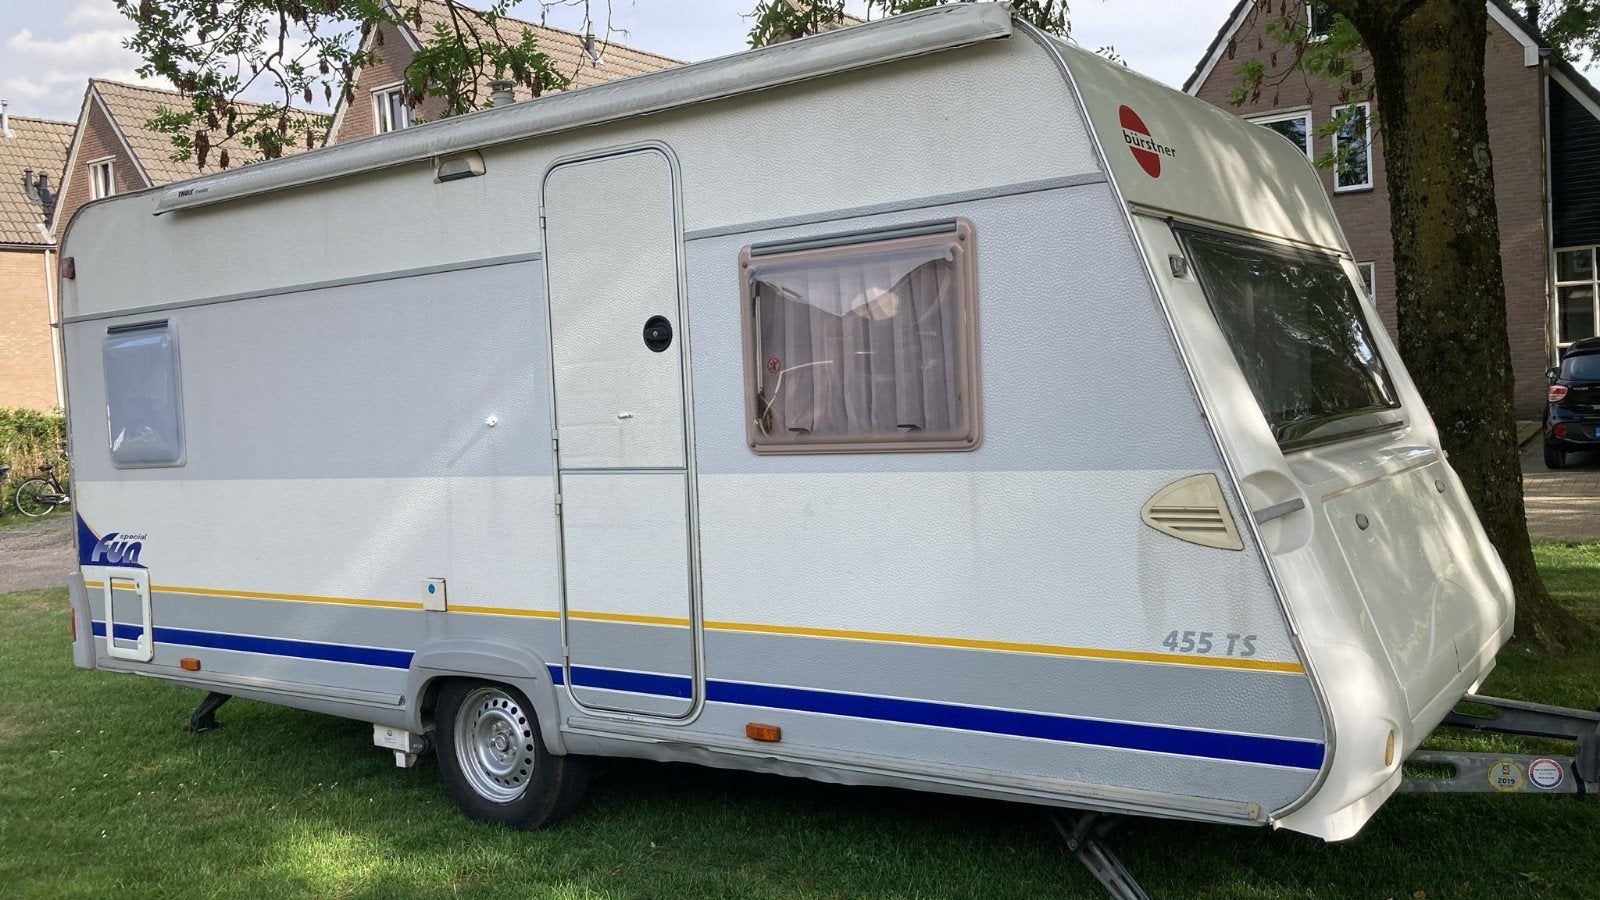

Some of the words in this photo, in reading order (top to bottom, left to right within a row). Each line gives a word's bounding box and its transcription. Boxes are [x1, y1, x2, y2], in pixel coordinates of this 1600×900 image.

[1122, 129, 1176, 158] bürstner
[119, 533, 148, 541] special
[1162, 630, 1213, 653] 455
[1226, 633, 1257, 657] TS
[1497, 777, 1516, 785] 2019
